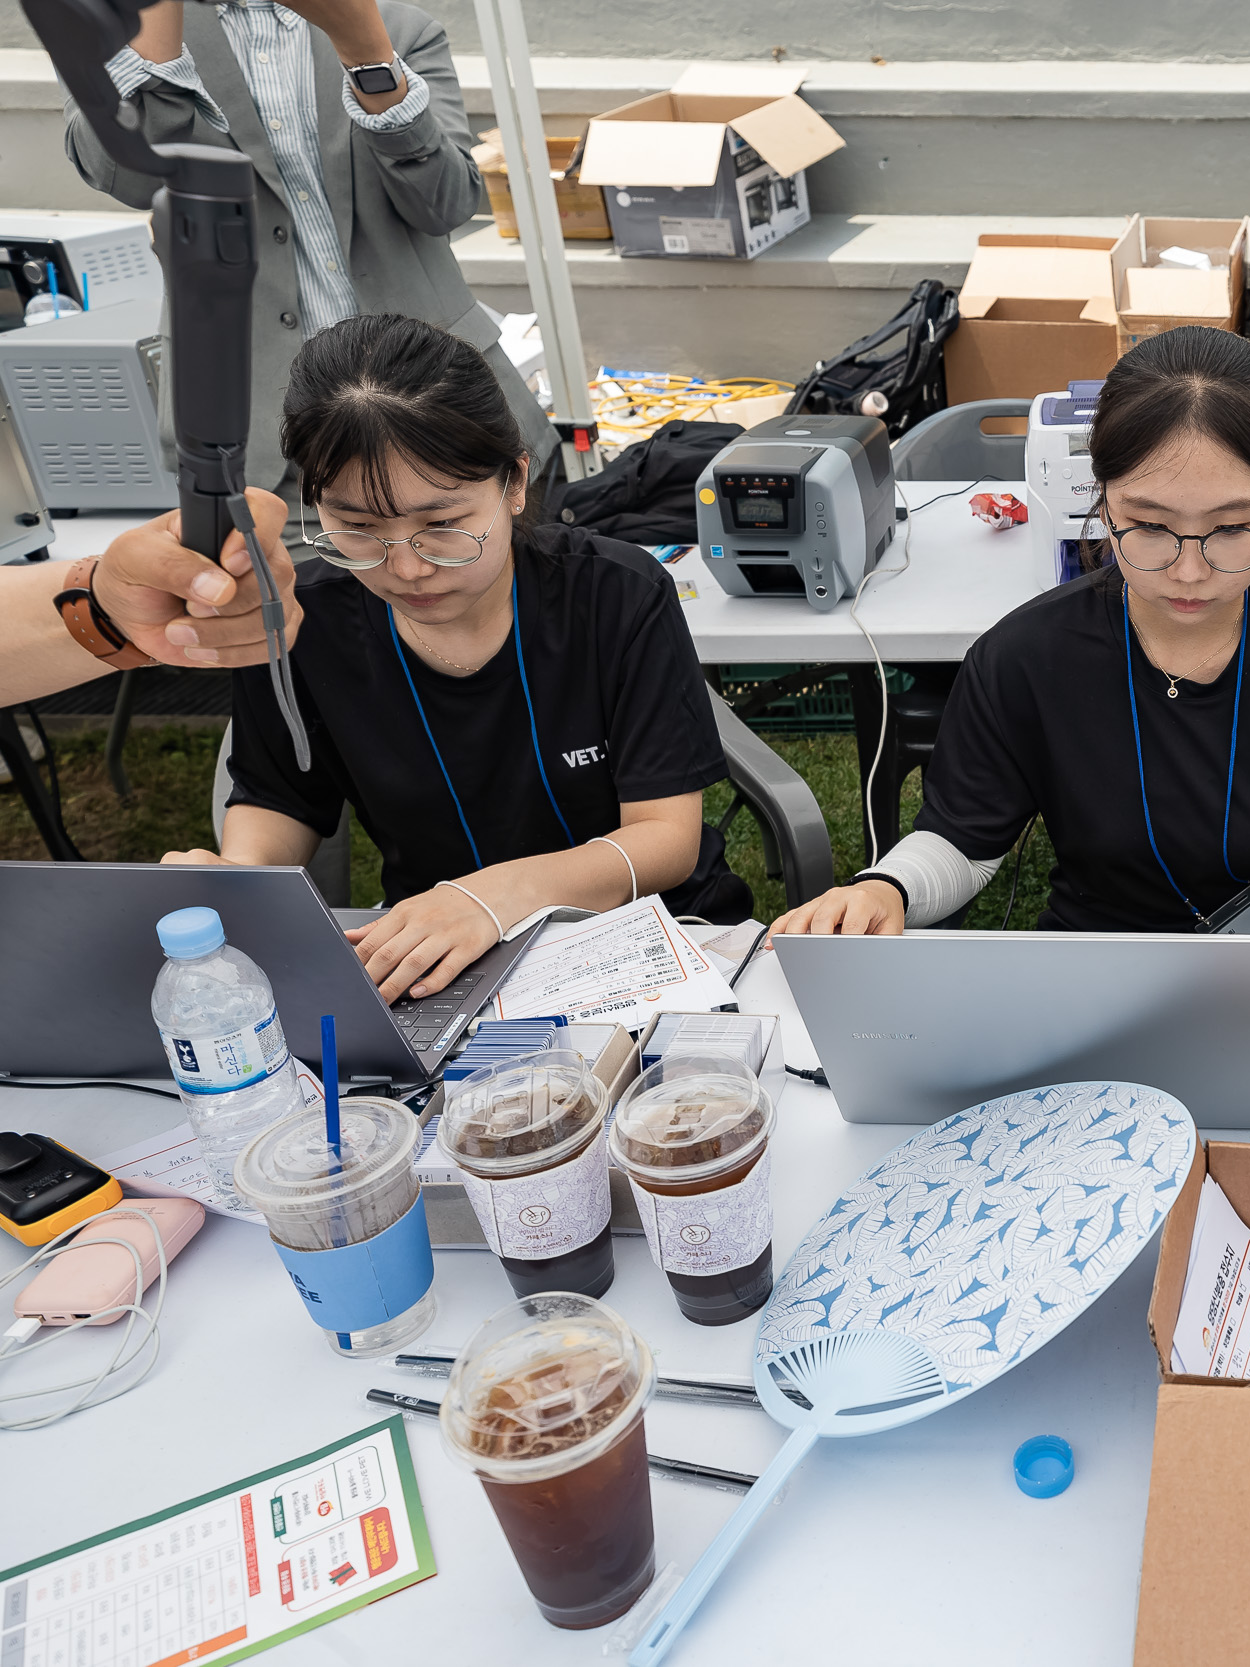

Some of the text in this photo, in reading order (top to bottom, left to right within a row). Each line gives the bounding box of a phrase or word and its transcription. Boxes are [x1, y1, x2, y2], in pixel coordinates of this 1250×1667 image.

[562, 746, 606, 768] VET.
[220, 1043, 242, 1076] 마신다
[1218, 1242, 1236, 1278] 접수지
[358, 1454, 372, 1500] WE LOVE PET
